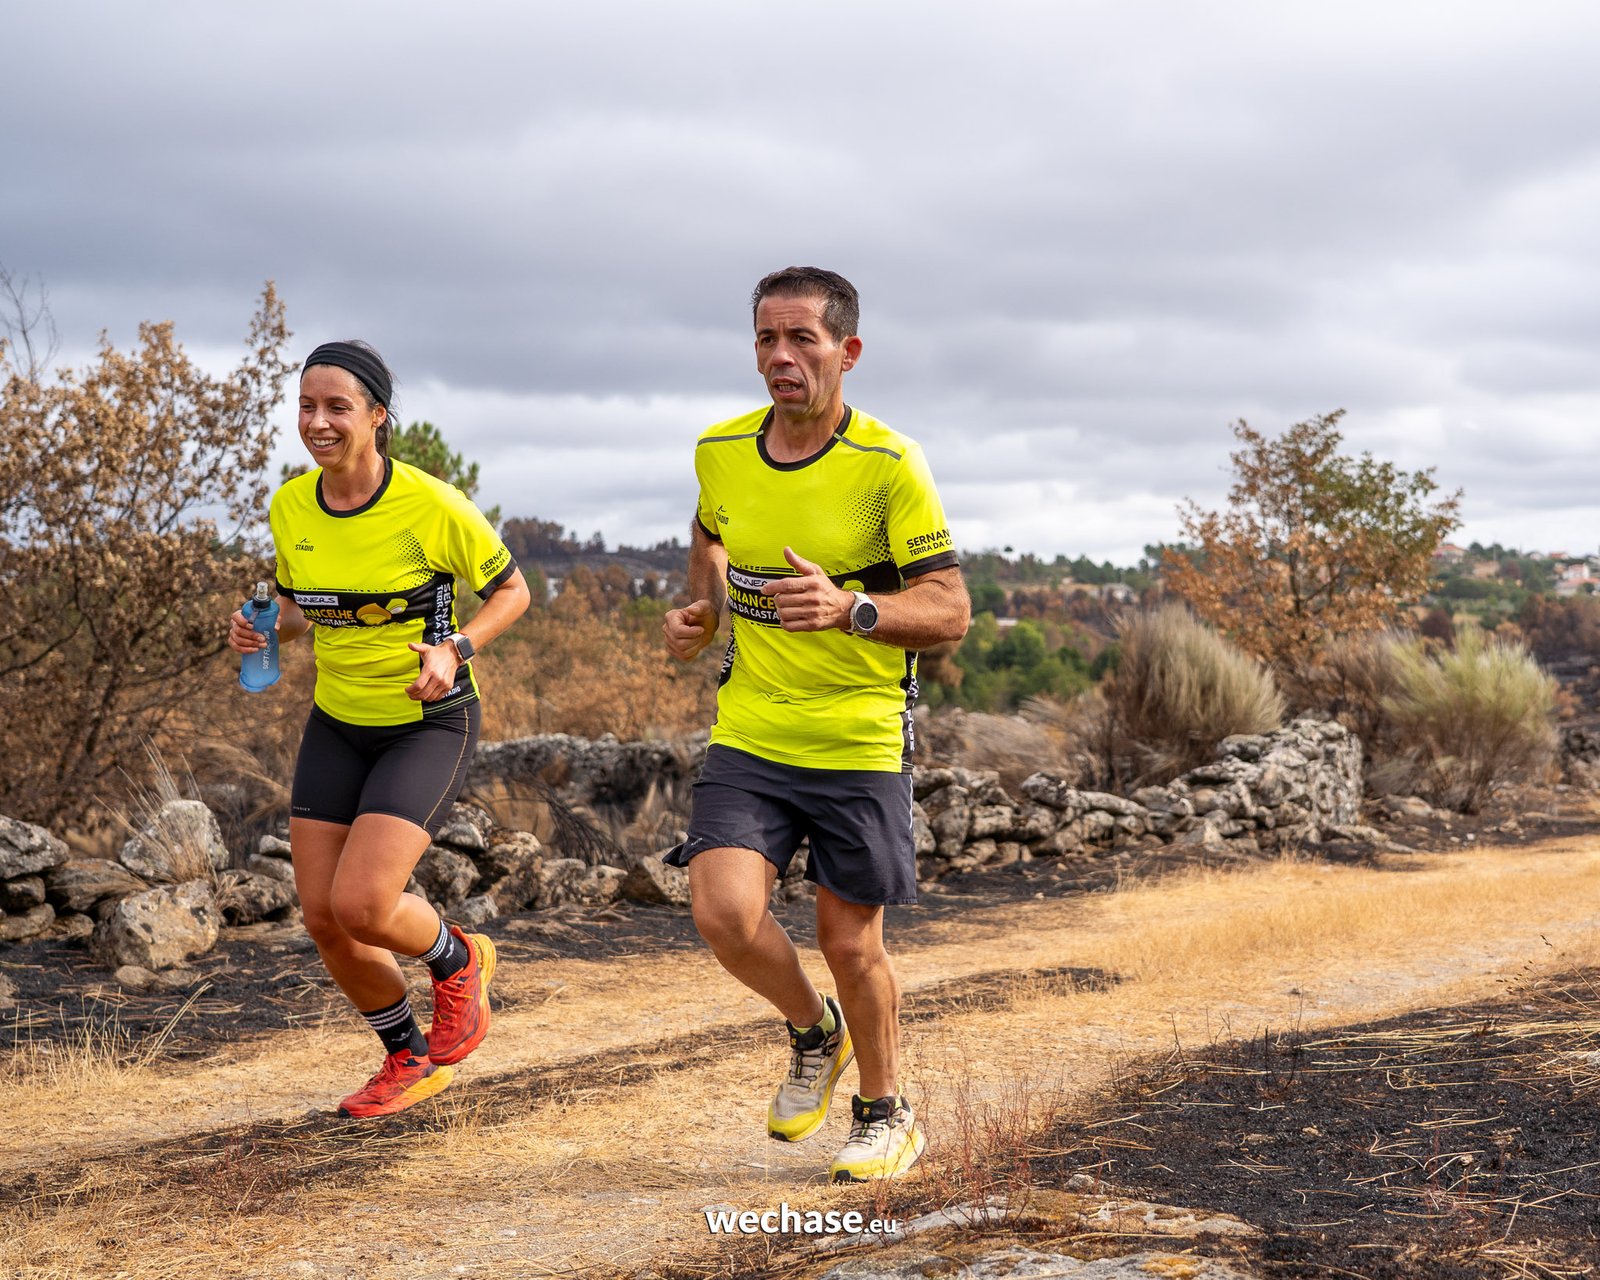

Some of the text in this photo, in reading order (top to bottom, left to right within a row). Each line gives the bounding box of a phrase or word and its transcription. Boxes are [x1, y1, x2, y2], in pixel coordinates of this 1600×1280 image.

[909, 545, 932, 556] TERRA
[933, 541, 944, 549] DA
[750, 608, 781, 620] CASTA
